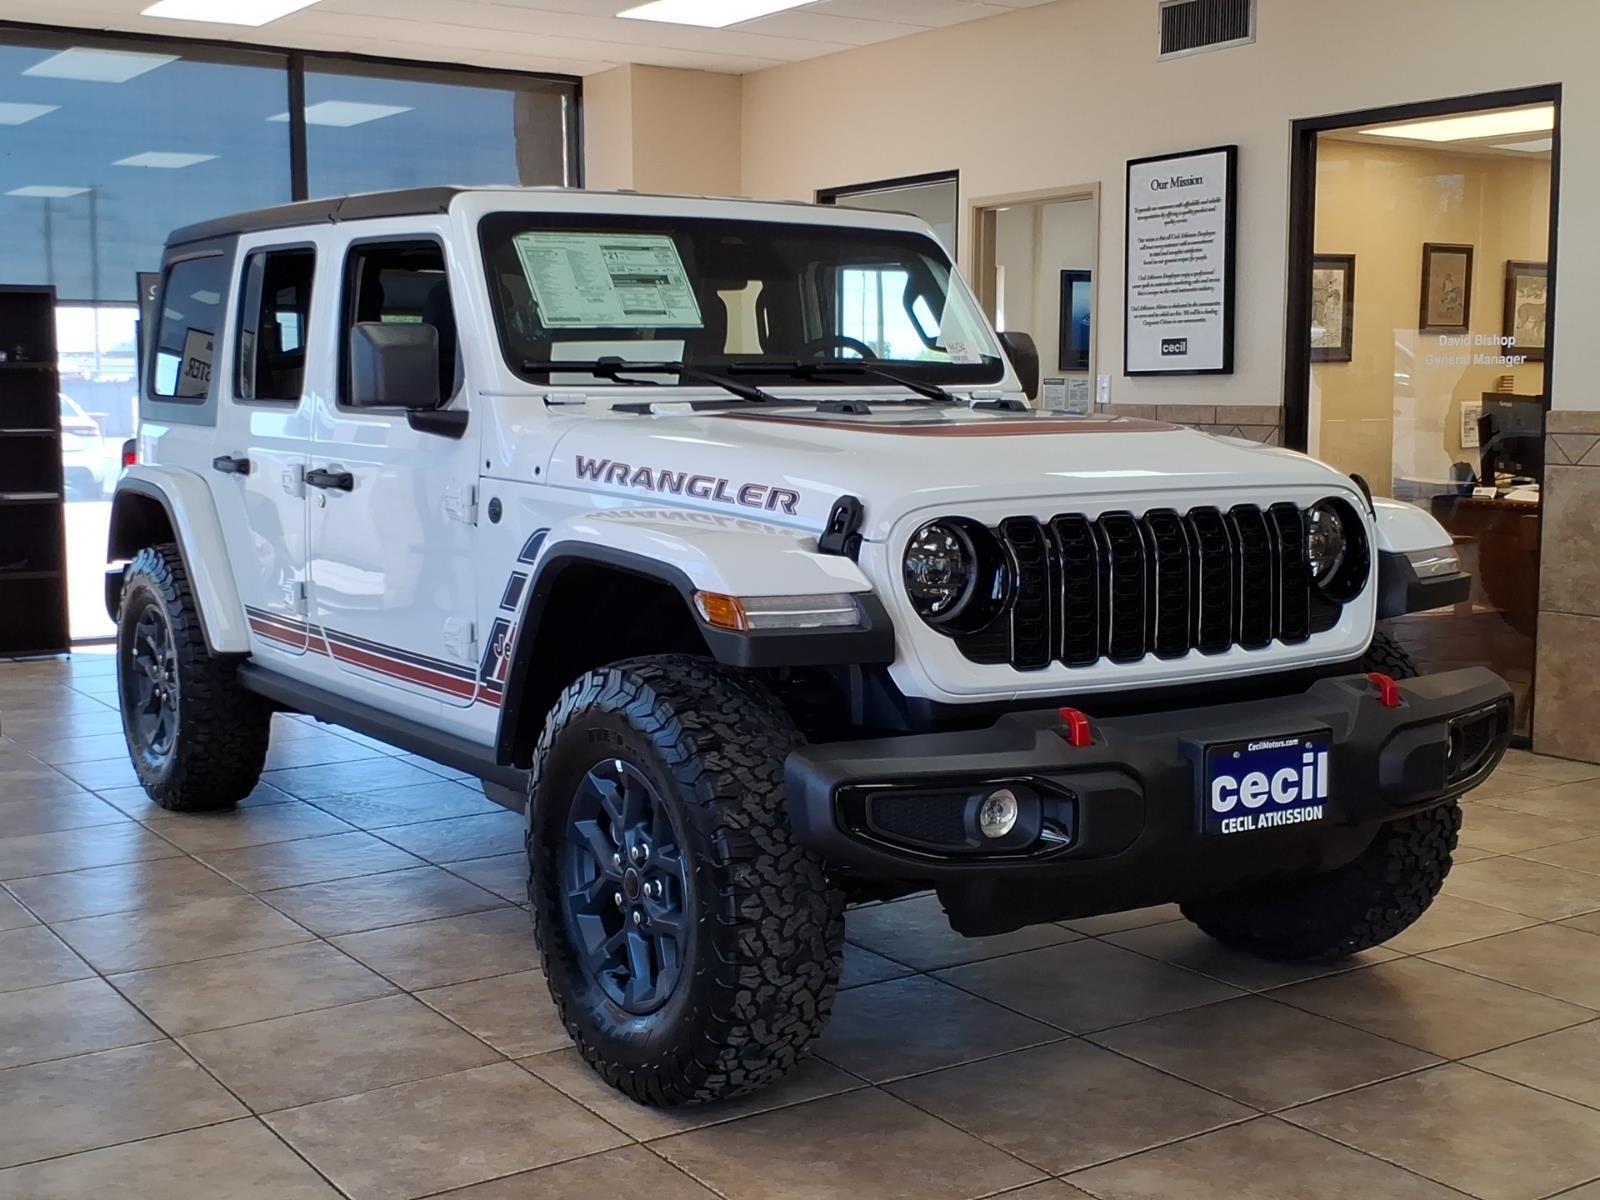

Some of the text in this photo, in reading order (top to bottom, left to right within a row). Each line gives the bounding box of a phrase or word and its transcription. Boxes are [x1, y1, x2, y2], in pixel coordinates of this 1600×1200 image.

[1150, 174, 1203, 191] Our Mission
[1162, 341, 1186, 353] cecil
[1439, 334, 1516, 348] David Bishop
[1425, 354, 1527, 368] General Manager
[575, 455, 800, 516] WRANGLER
[493, 633, 511, 660] Je
[1248, 739, 1299, 752] CecilMotors.com
[1211, 751, 1328, 813] cecil
[1221, 805, 1323, 834] CECIL ATKISSION
